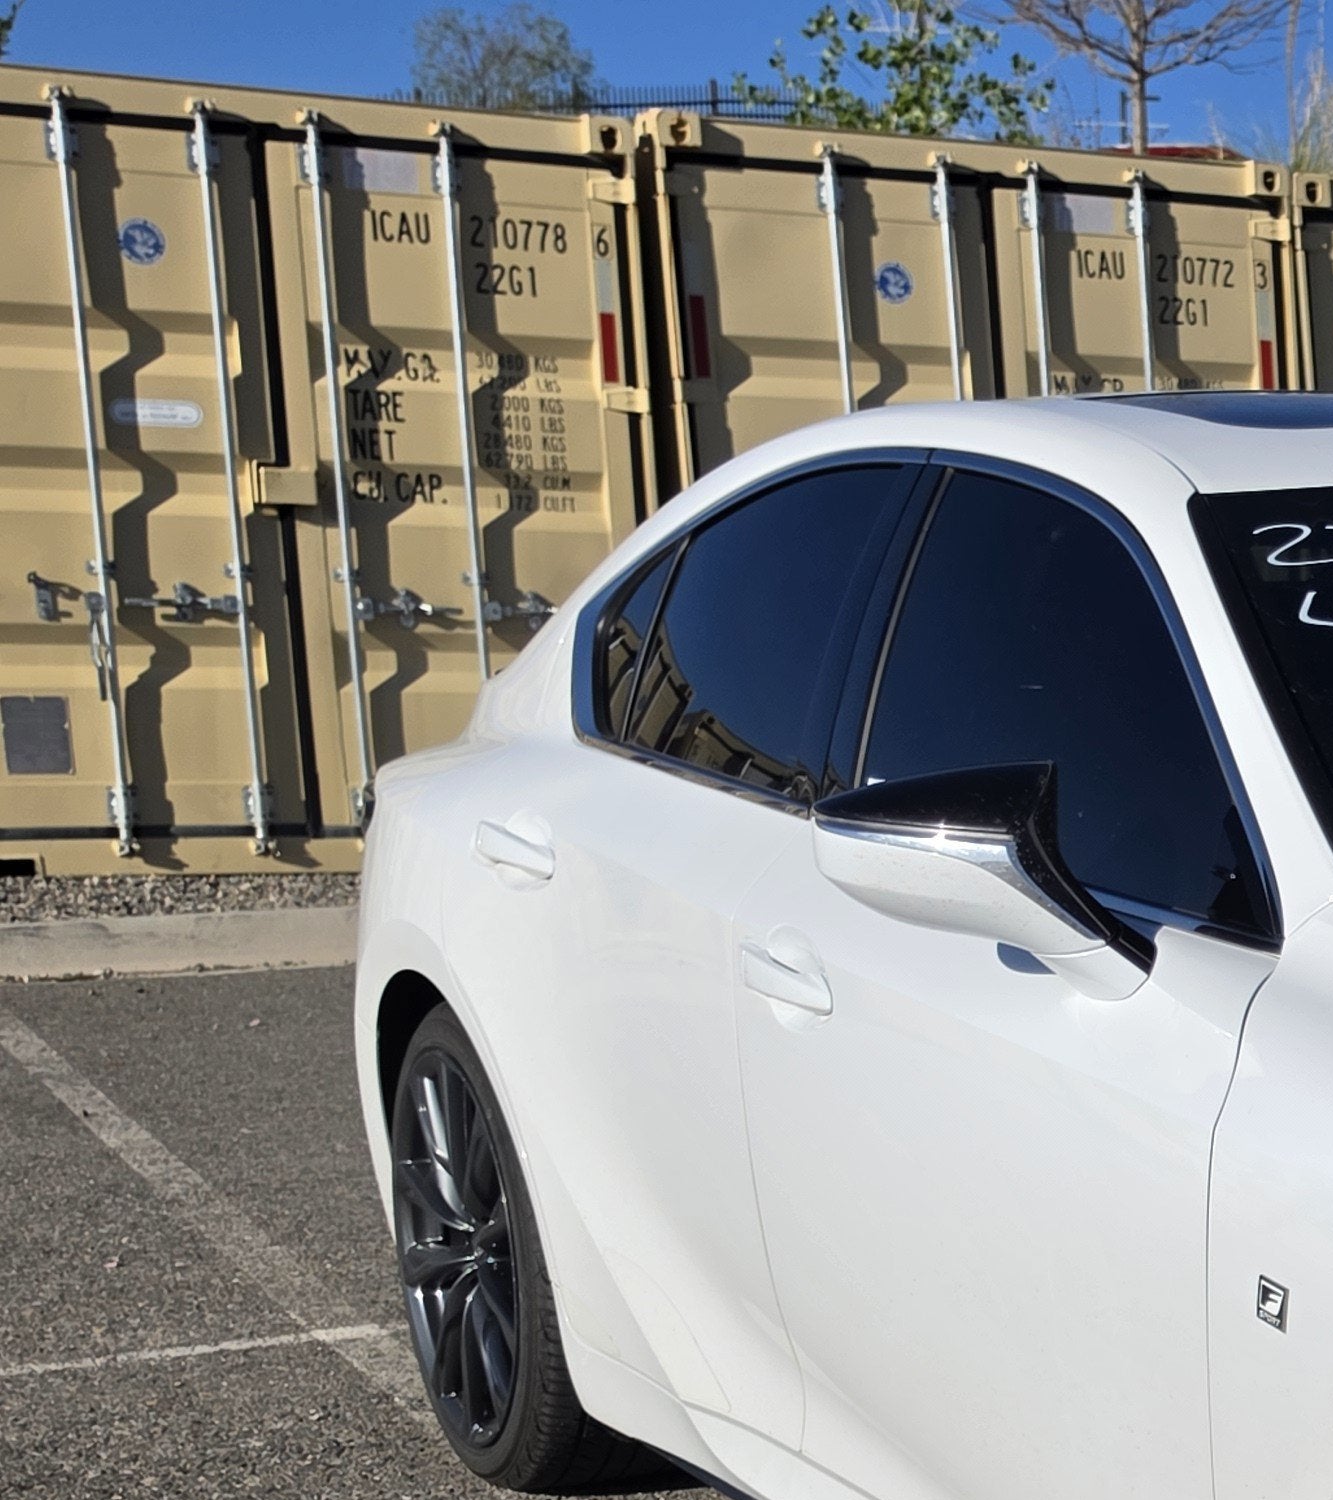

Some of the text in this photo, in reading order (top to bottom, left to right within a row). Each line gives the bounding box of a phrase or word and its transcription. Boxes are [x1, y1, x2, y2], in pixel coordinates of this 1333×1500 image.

[370, 209, 610, 258] ICAU 210778 6
[475, 263, 537, 298] 22G1
[1077, 249, 1268, 290] ICAU 210772 3
[1157, 297, 1209, 327] 22G1
[348, 388, 407, 423] TARE
[540, 416, 566, 434] LBS
[351, 428, 397, 463] NET
